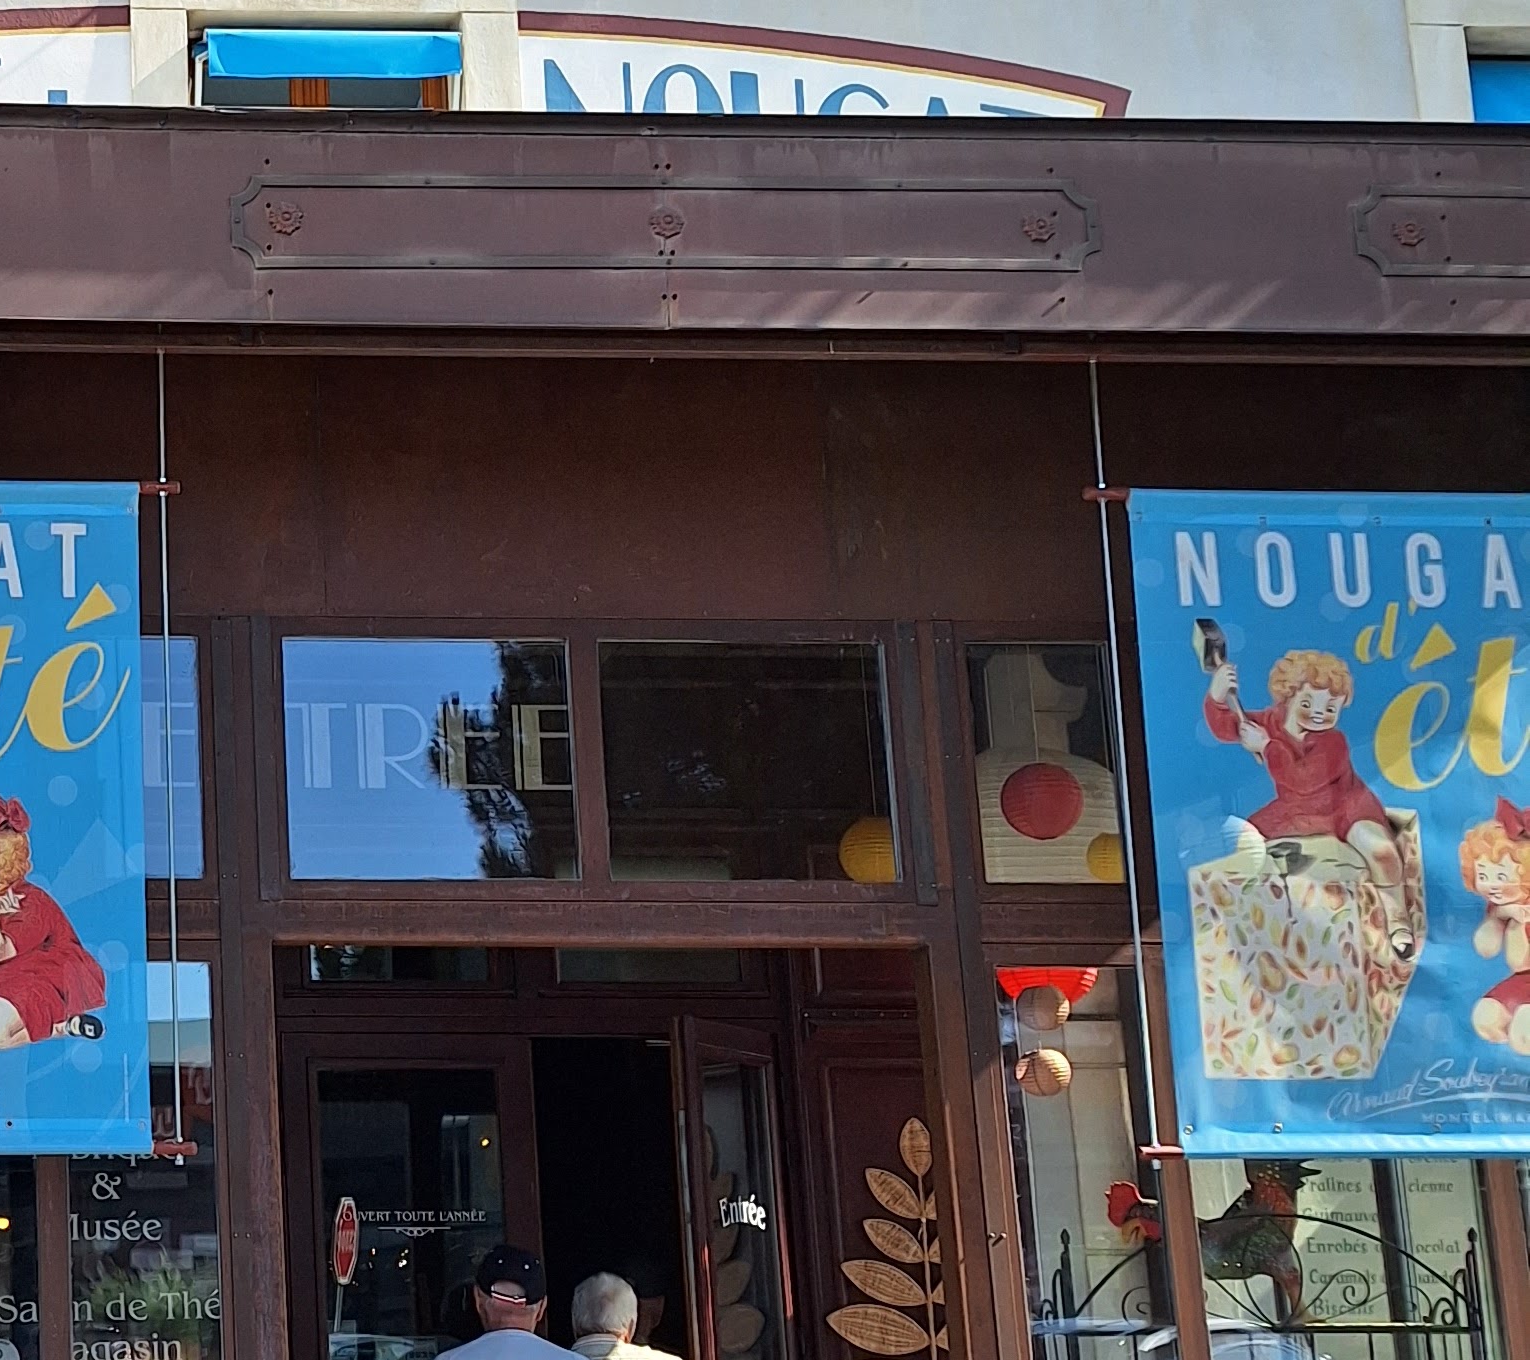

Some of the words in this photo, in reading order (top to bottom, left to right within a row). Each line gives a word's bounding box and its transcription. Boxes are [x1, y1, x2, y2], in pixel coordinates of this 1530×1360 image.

[1174, 531, 1523, 609] NOUGA
[142, 702, 572, 790] ETREE
[91, 1172, 121, 1200] &
[343, 1211, 391, 1222] OUVERT
[394, 1210, 435, 1222] TOUTE
[439, 1209, 486, 1222] L'ANNÉE
[719, 1194, 767, 1230] Entrée
[105, 1292, 148, 1321] de
[159, 1289, 221, 1321] Thé
